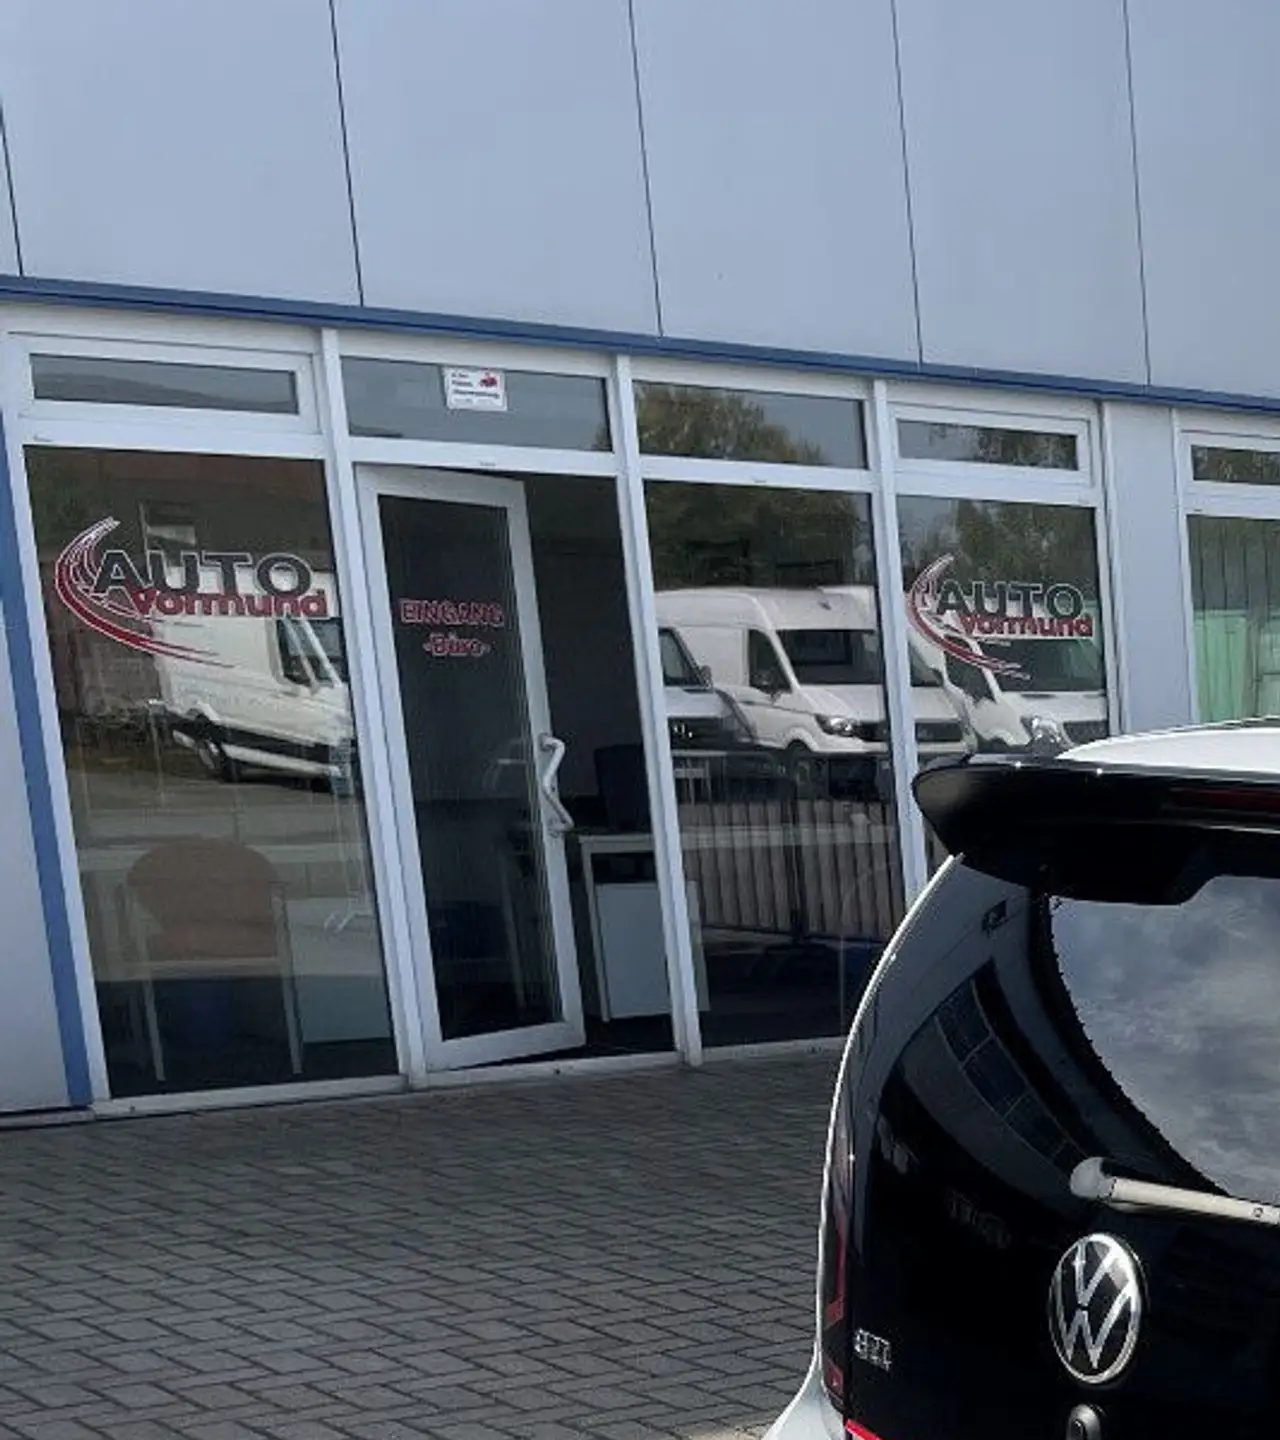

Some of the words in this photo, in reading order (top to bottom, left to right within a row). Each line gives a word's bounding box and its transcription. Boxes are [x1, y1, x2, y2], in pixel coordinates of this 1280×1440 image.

[90, 549, 314, 600] AUTO
[400, 599, 504, 627] EINGANG
[936, 578, 1085, 619] AUTO
